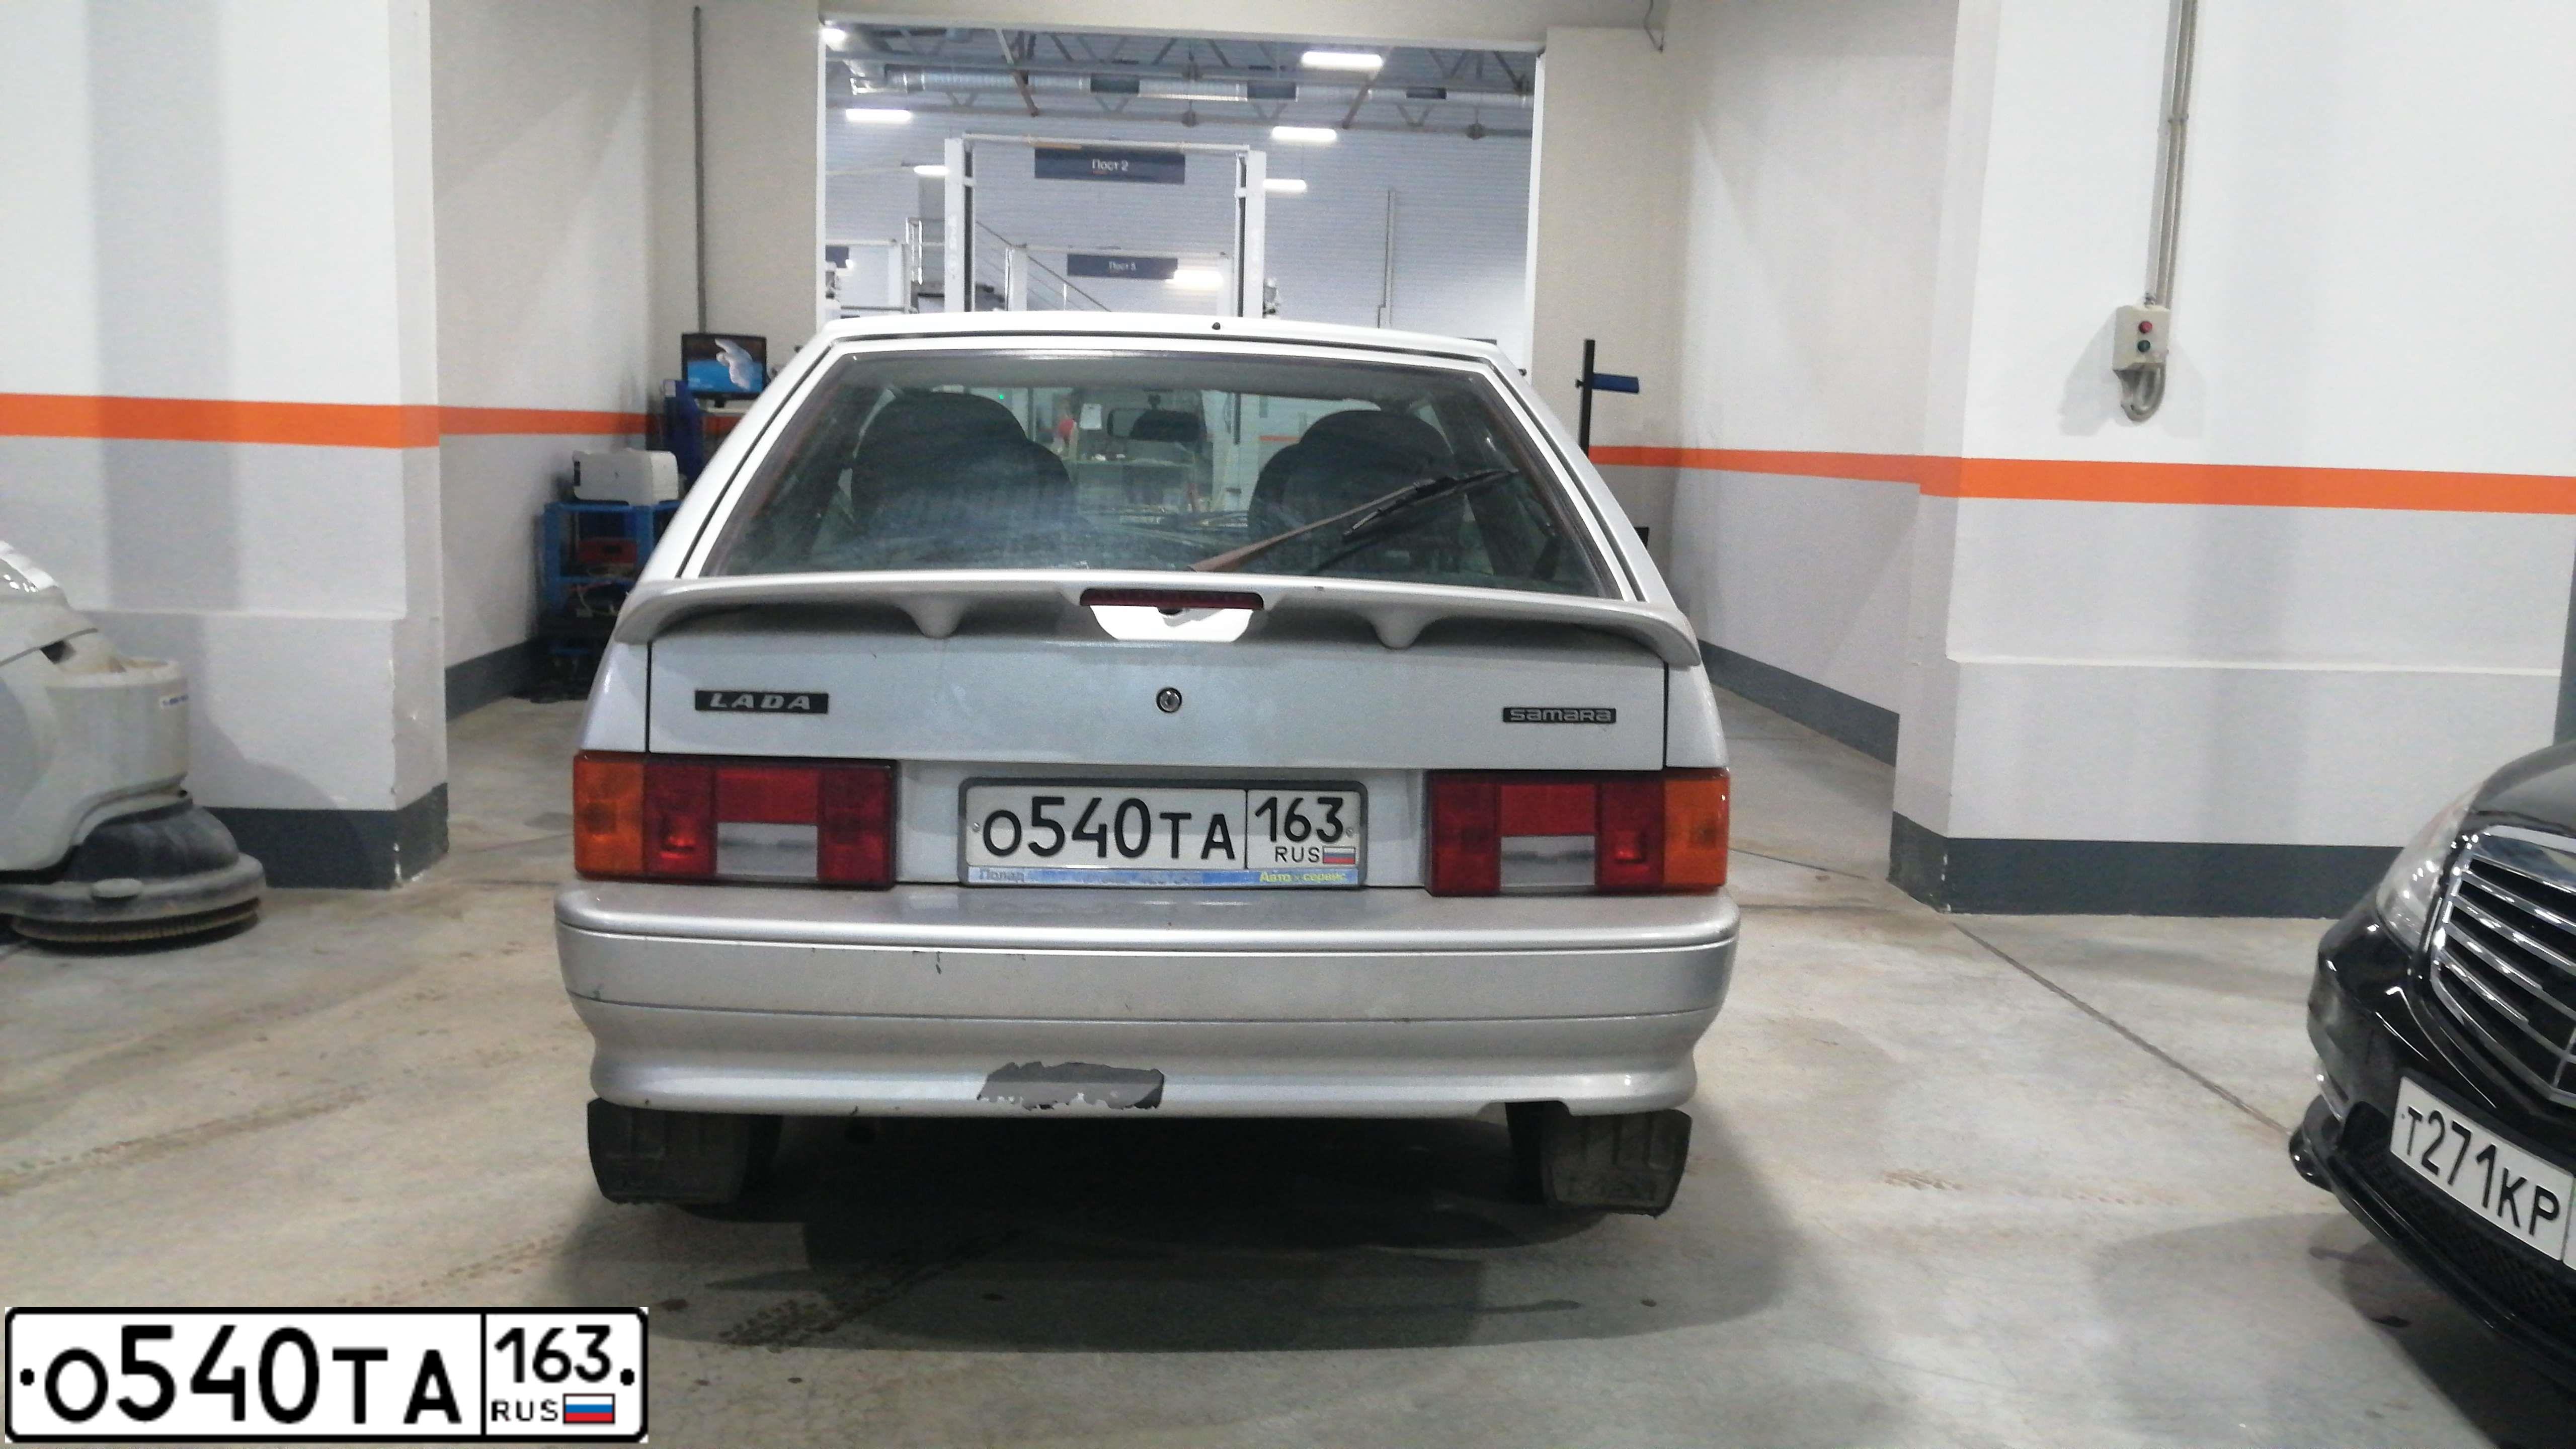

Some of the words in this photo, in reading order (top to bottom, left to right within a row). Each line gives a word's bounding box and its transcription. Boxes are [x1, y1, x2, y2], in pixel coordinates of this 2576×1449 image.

[1121, 159, 1129, 172] 2
[709, 692, 811, 710] LADA
[983, 796, 1236, 860] О540ТА
[1255, 797, 1343, 843] 163
[1274, 846, 1320, 862] RUS
[1259, 871, 1292, 882] Авто
[2407, 1105, 2560, 1236] Т271КР
